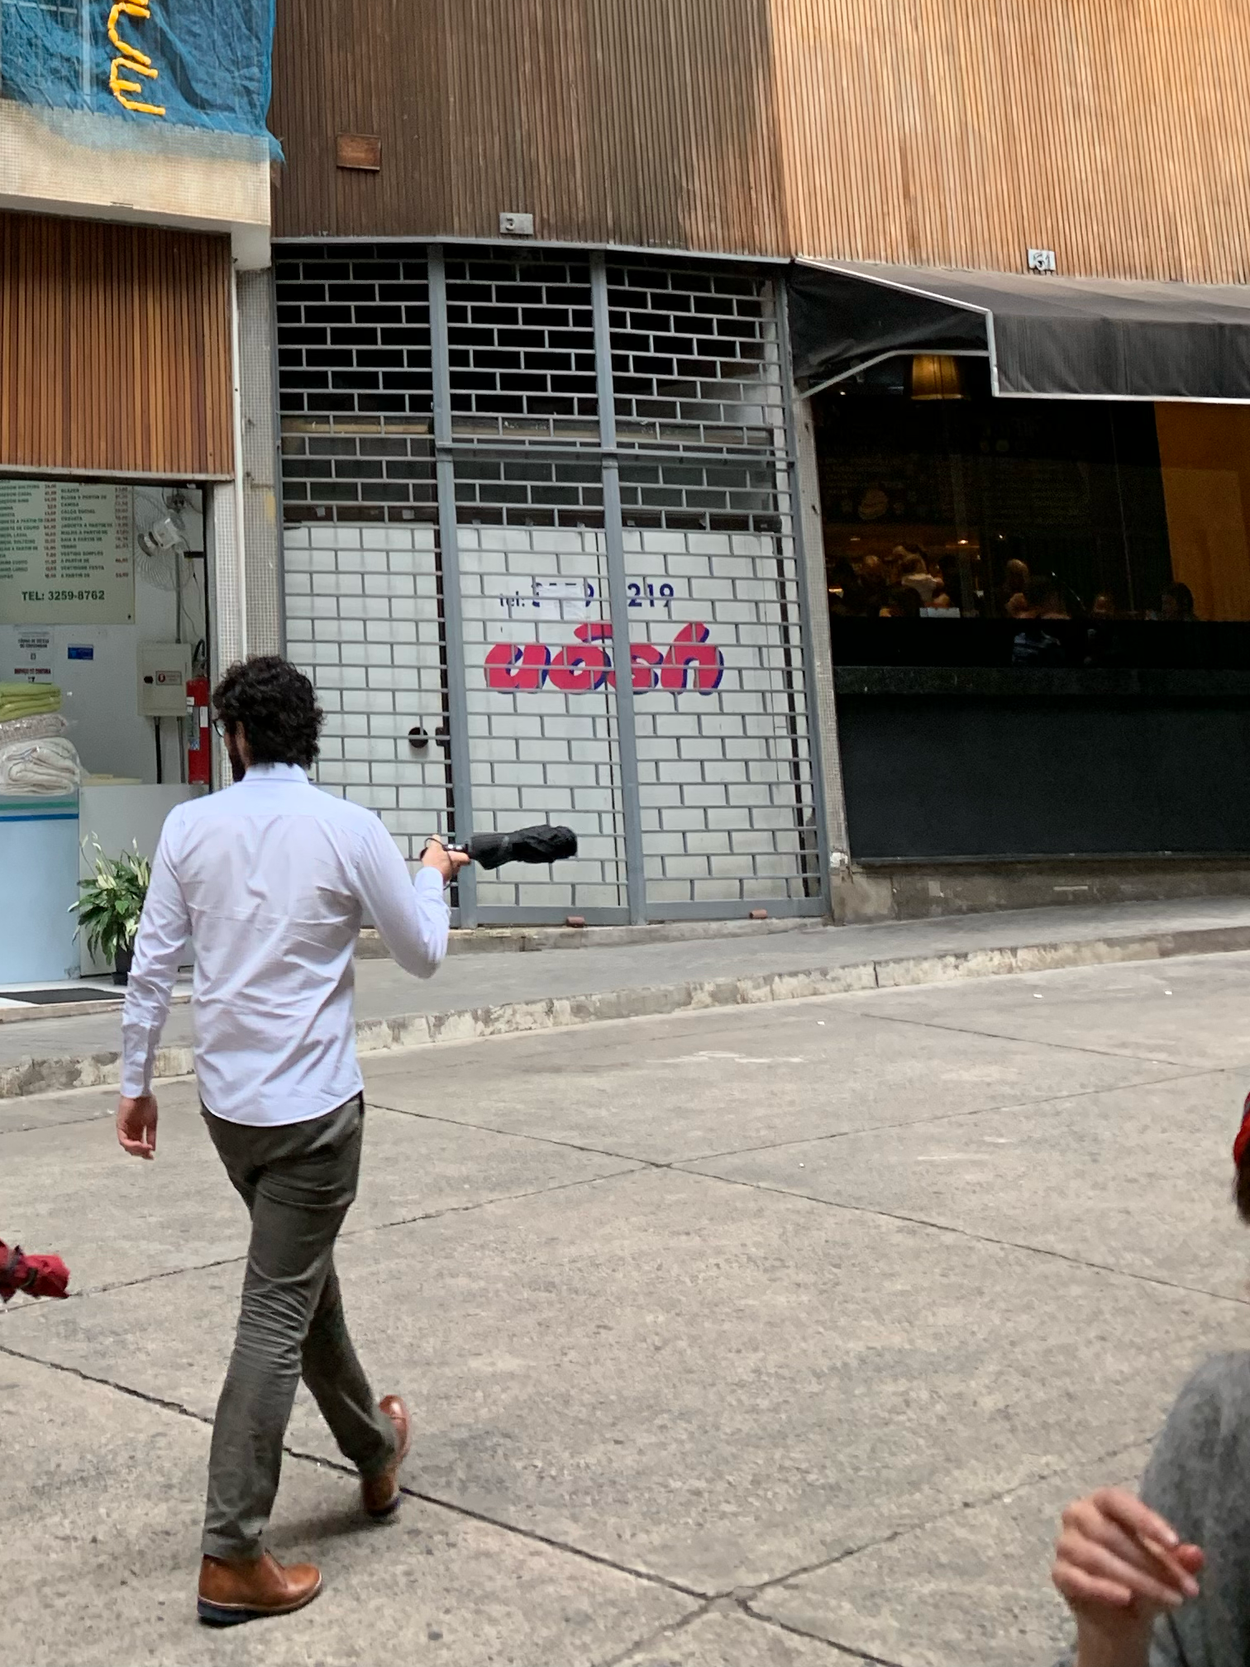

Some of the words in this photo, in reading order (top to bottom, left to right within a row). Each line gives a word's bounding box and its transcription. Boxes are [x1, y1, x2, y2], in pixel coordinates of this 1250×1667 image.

[22, 590, 45, 601] TEL:
[47, 590, 106, 601] 3259-8762
[499, 591, 526, 607] tel:
